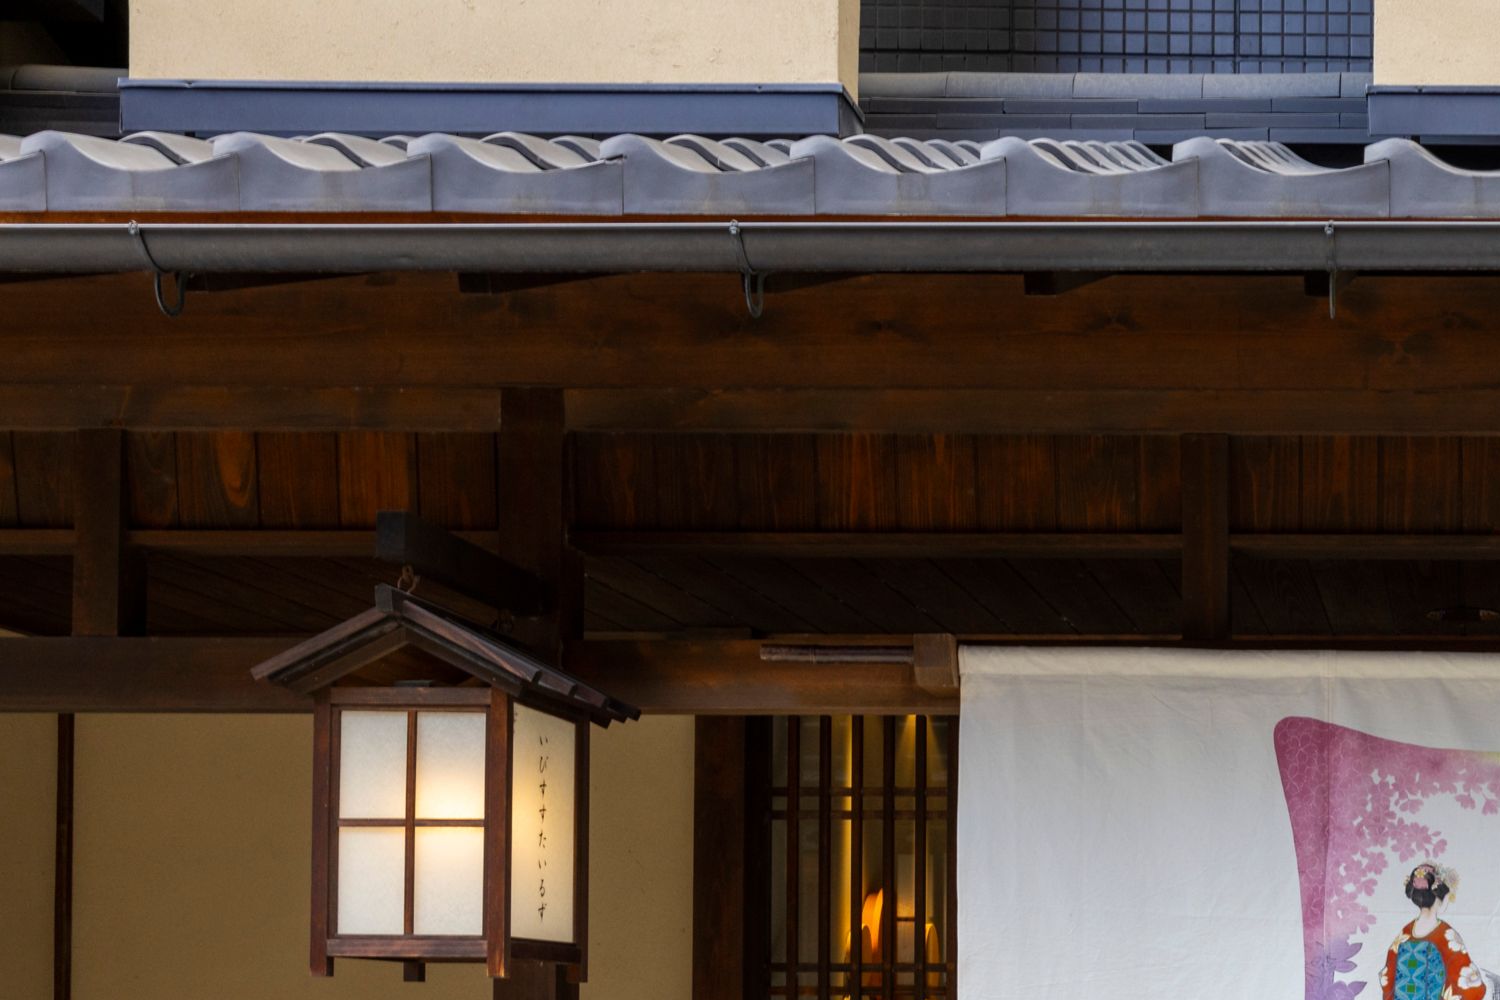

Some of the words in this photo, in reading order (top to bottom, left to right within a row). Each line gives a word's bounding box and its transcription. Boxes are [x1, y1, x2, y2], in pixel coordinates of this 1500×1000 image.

[537, 735, 550, 923] いびすすたいるず
